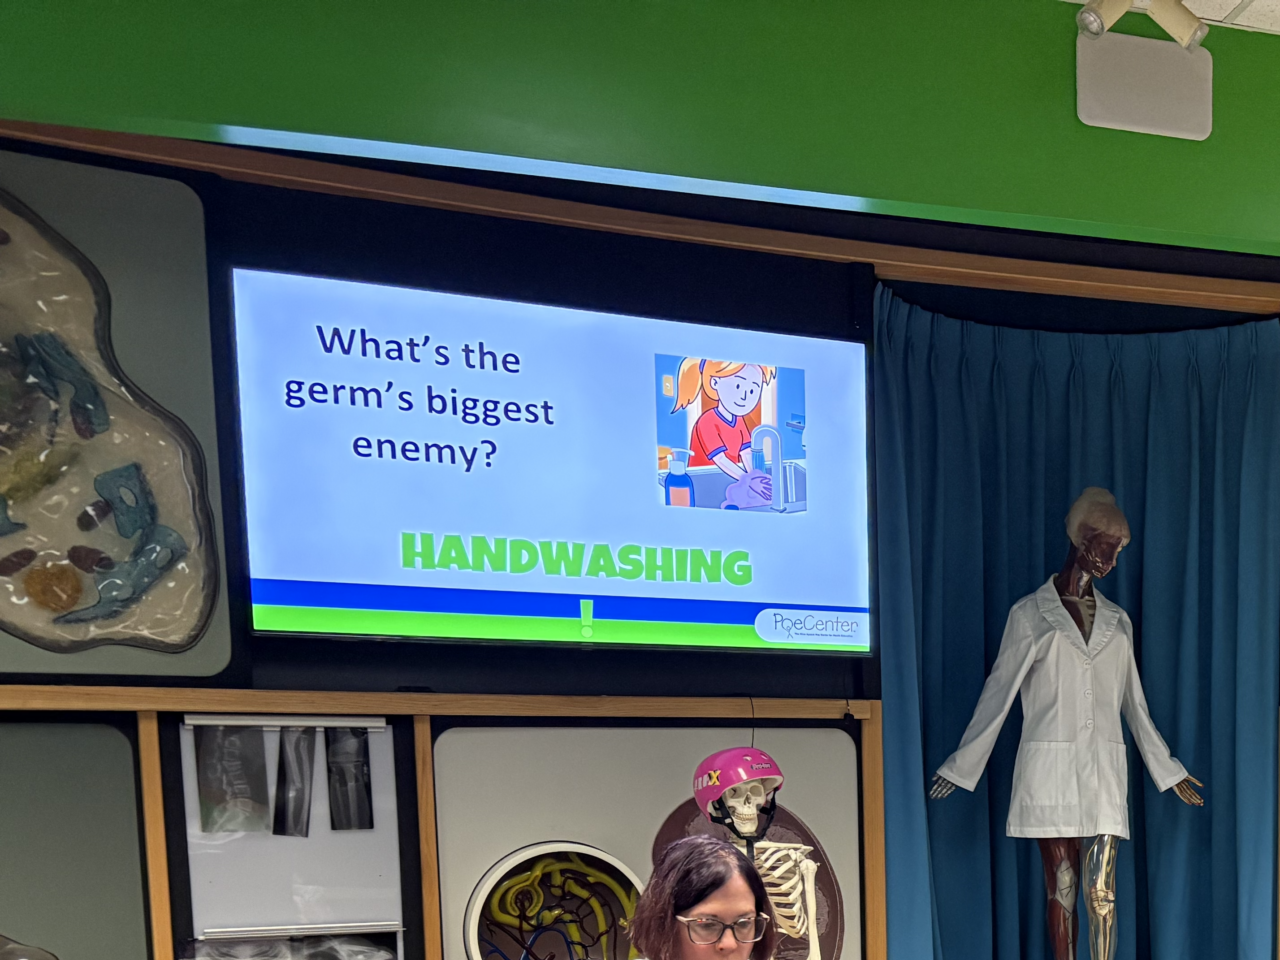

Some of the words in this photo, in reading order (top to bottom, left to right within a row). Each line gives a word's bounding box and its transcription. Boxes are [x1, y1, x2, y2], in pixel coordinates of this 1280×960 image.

[315, 324, 451, 367] What's
[461, 341, 522, 374] the
[284, 379, 414, 414] germ's
[427, 385, 555, 428] biggest
[351, 431, 499, 473] enemy?
[400, 530, 754, 587] HANDWASHING
